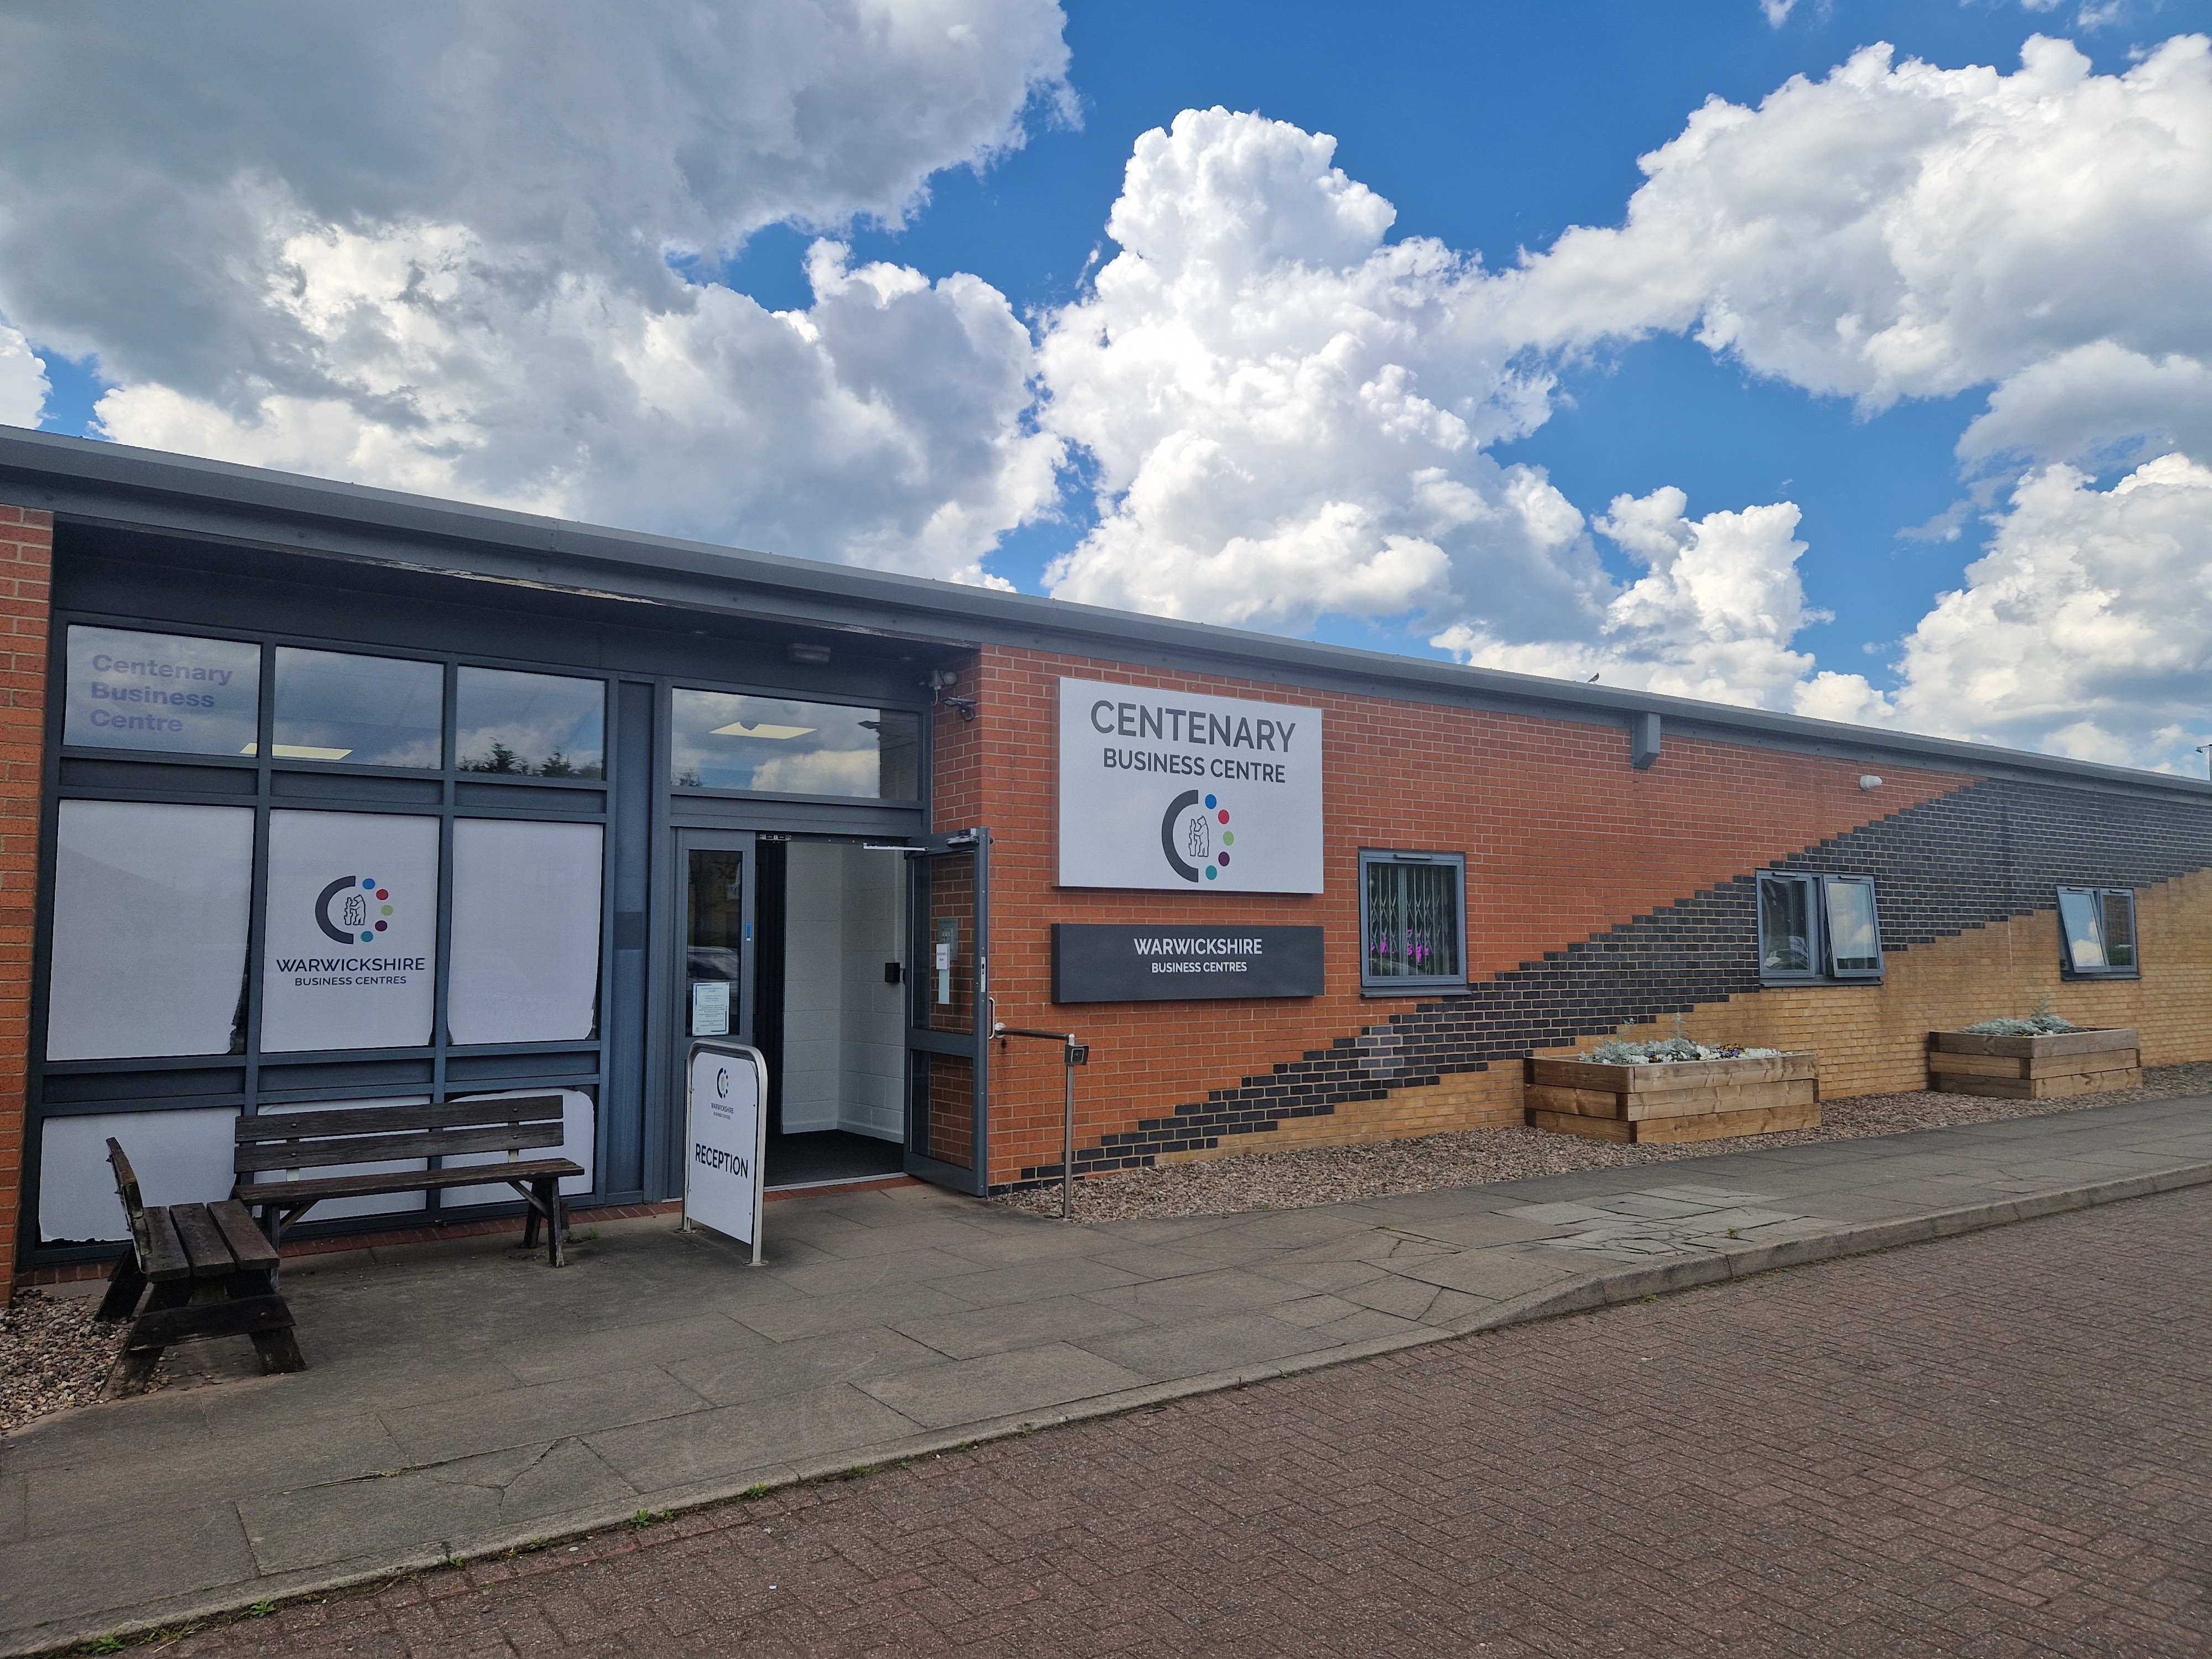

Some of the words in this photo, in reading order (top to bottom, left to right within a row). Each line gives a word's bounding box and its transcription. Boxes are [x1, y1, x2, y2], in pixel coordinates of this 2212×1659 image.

[92, 654, 233, 686] Centenary
[91, 681, 215, 708] Business
[90, 709, 183, 732] Centre
[1091, 700, 1296, 752] CENTENARY
[1104, 748, 1205, 776] BUSINESS
[1210, 759, 1286, 784] CENTRE
[1134, 938, 1262, 955] WARWICKSHIRE
[276, 958, 425, 972] WARWICKSHIRE
[1151, 962, 1202, 973] BUSINESS
[1203, 961, 1248, 972] CENTRES
[295, 977, 352, 986] BUSINESS
[356, 976, 406, 985] CENTRES
[695, 1143, 748, 1179] RECEPTION
